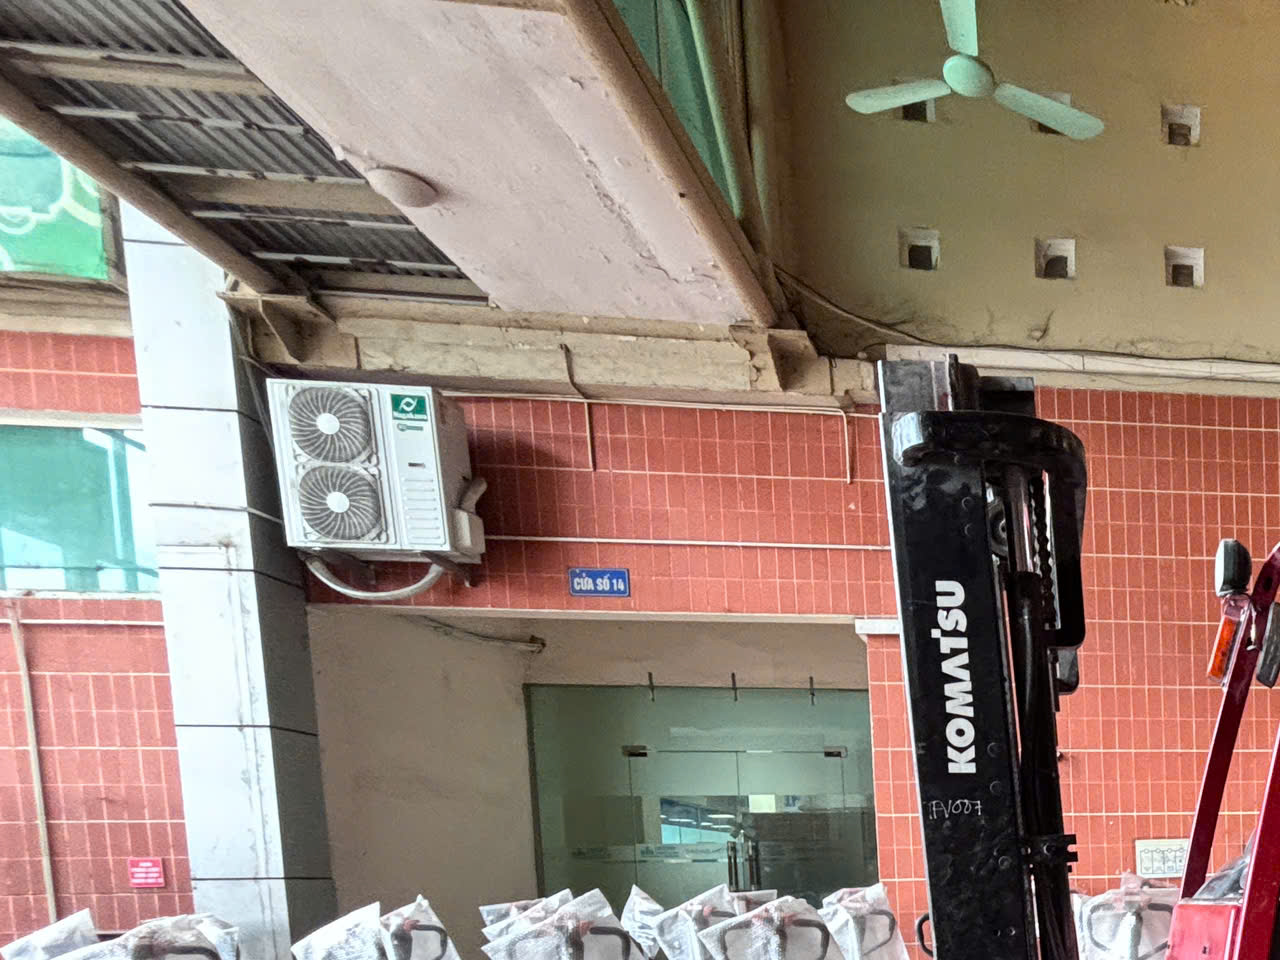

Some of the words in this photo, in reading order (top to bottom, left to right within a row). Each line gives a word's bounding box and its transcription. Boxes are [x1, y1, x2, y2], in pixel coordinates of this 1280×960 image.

[573, 572, 595, 591] CỬA
[595, 573, 611, 591] SỐ
[611, 578, 625, 592] 14
[931, 580, 977, 773] KOMATSU
